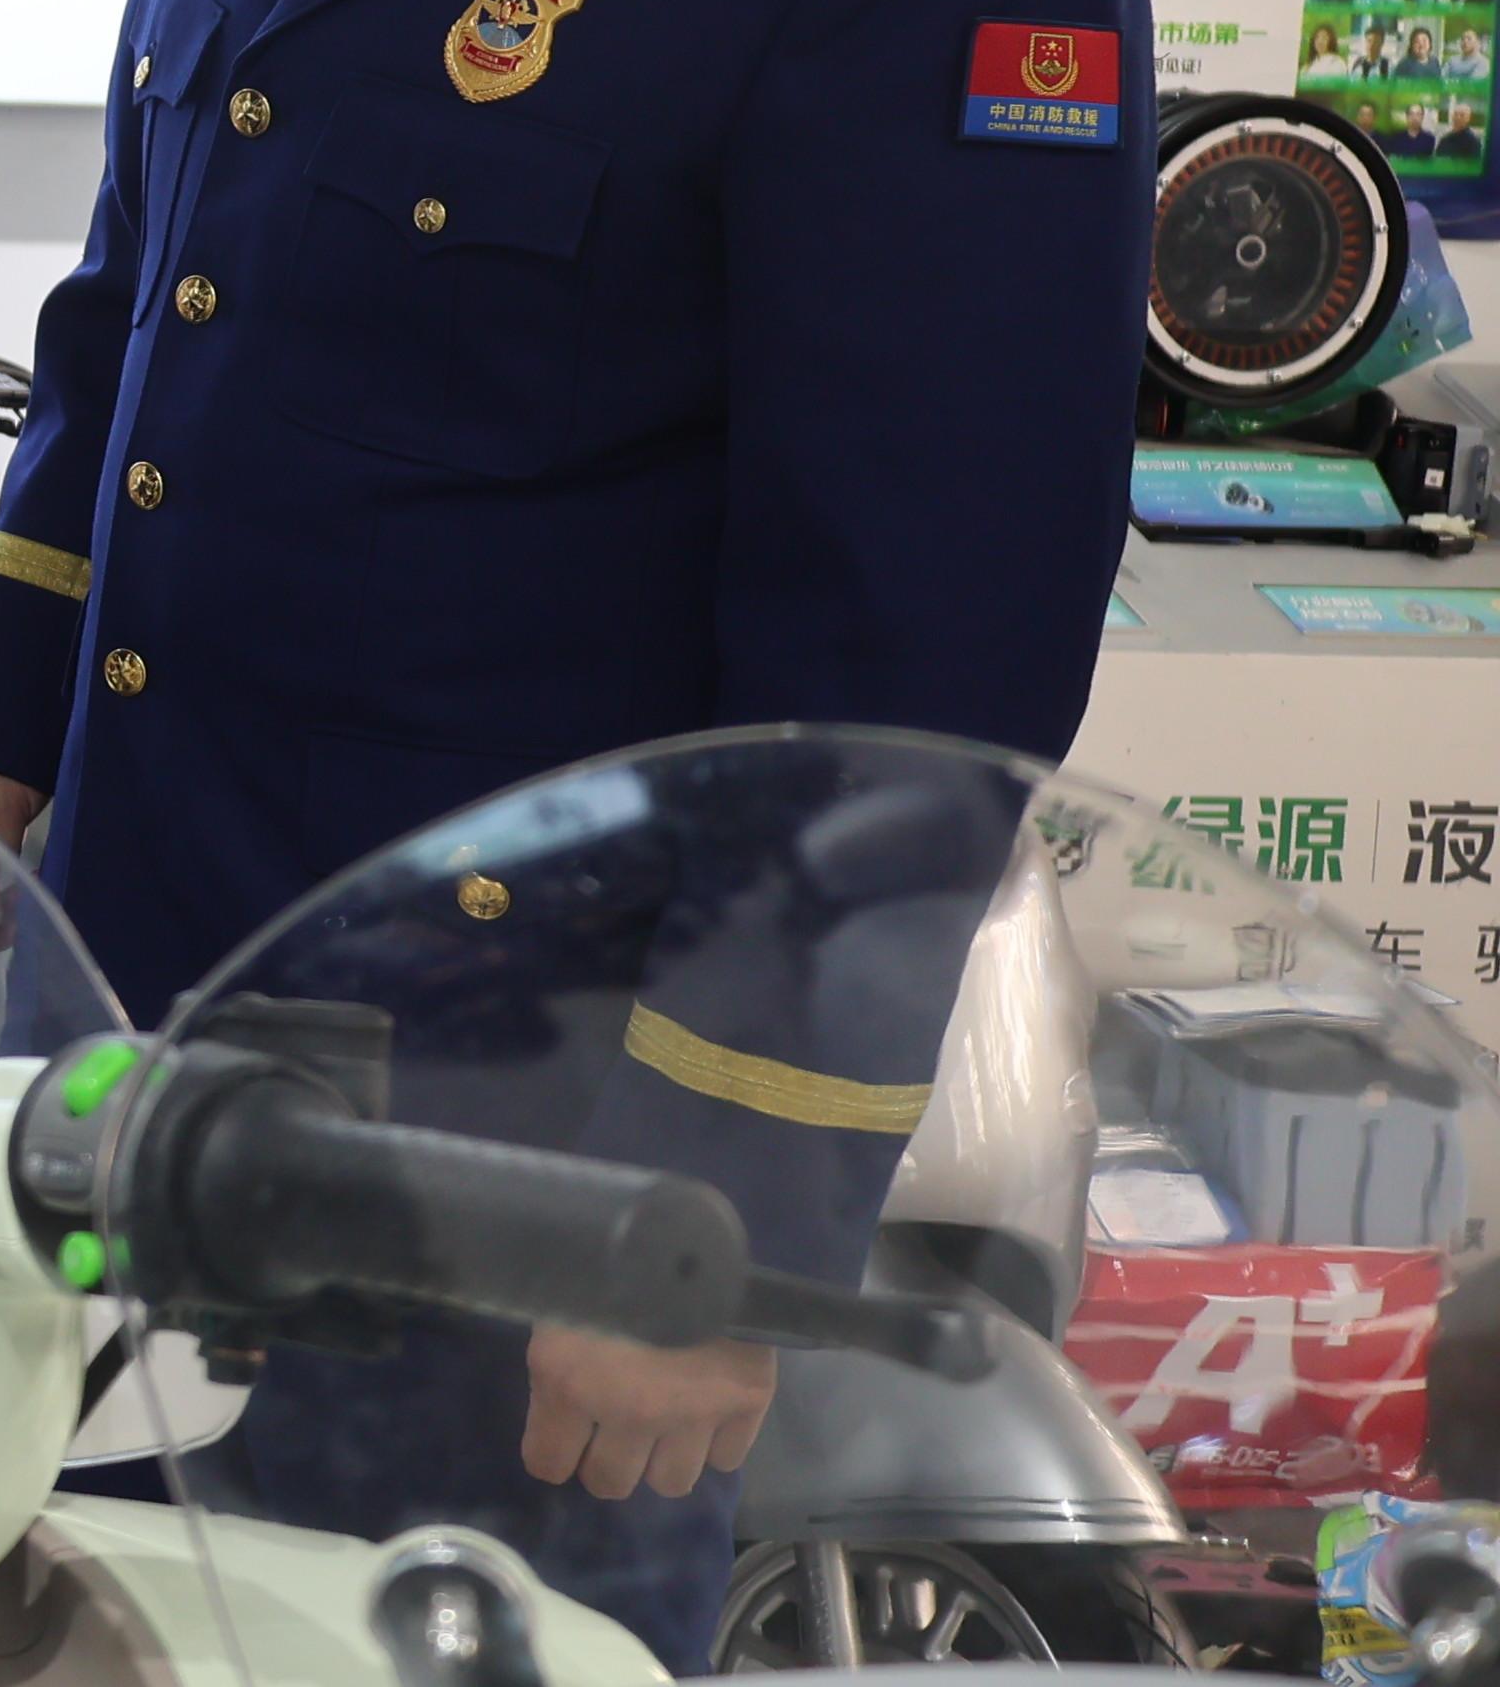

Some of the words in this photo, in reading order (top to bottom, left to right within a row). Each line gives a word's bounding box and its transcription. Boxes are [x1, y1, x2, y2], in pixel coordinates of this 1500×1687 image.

[1159, 21, 1268, 45] 市场第一
[989, 103, 1098, 126] 中国消防救援
[1118, 1263, 1383, 1434] A+
